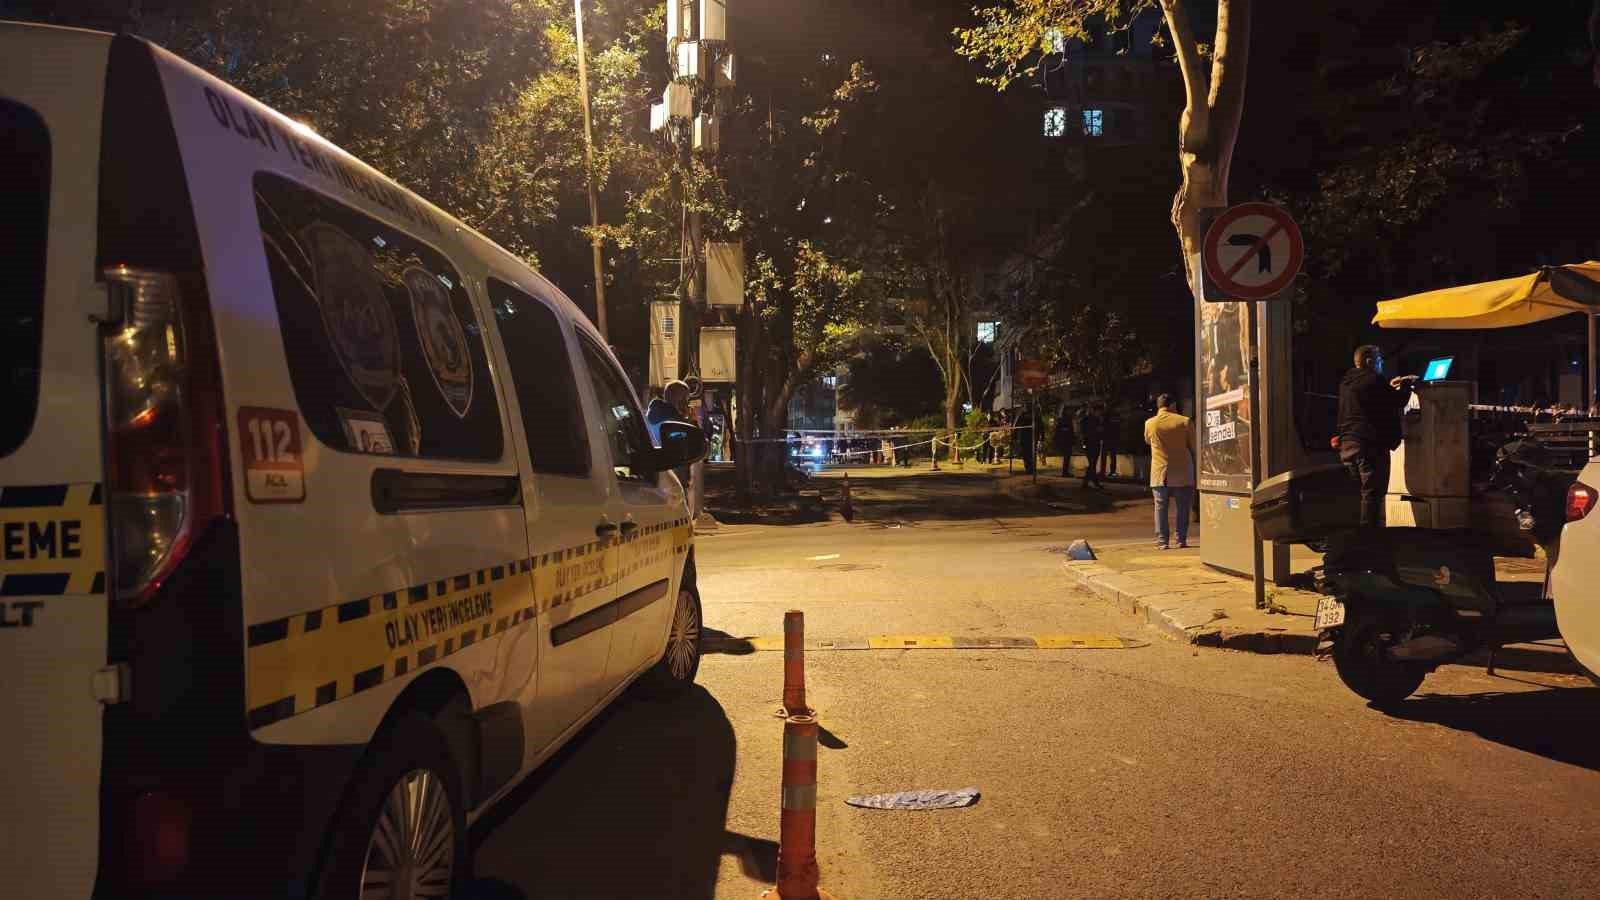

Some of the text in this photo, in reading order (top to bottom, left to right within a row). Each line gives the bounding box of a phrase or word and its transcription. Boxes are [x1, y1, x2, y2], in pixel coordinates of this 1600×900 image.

[204, 86, 278, 152] OLAY
[248, 417, 297, 464] 112
[4, 519, 81, 560] EME
[385, 612, 418, 650] OLAY
